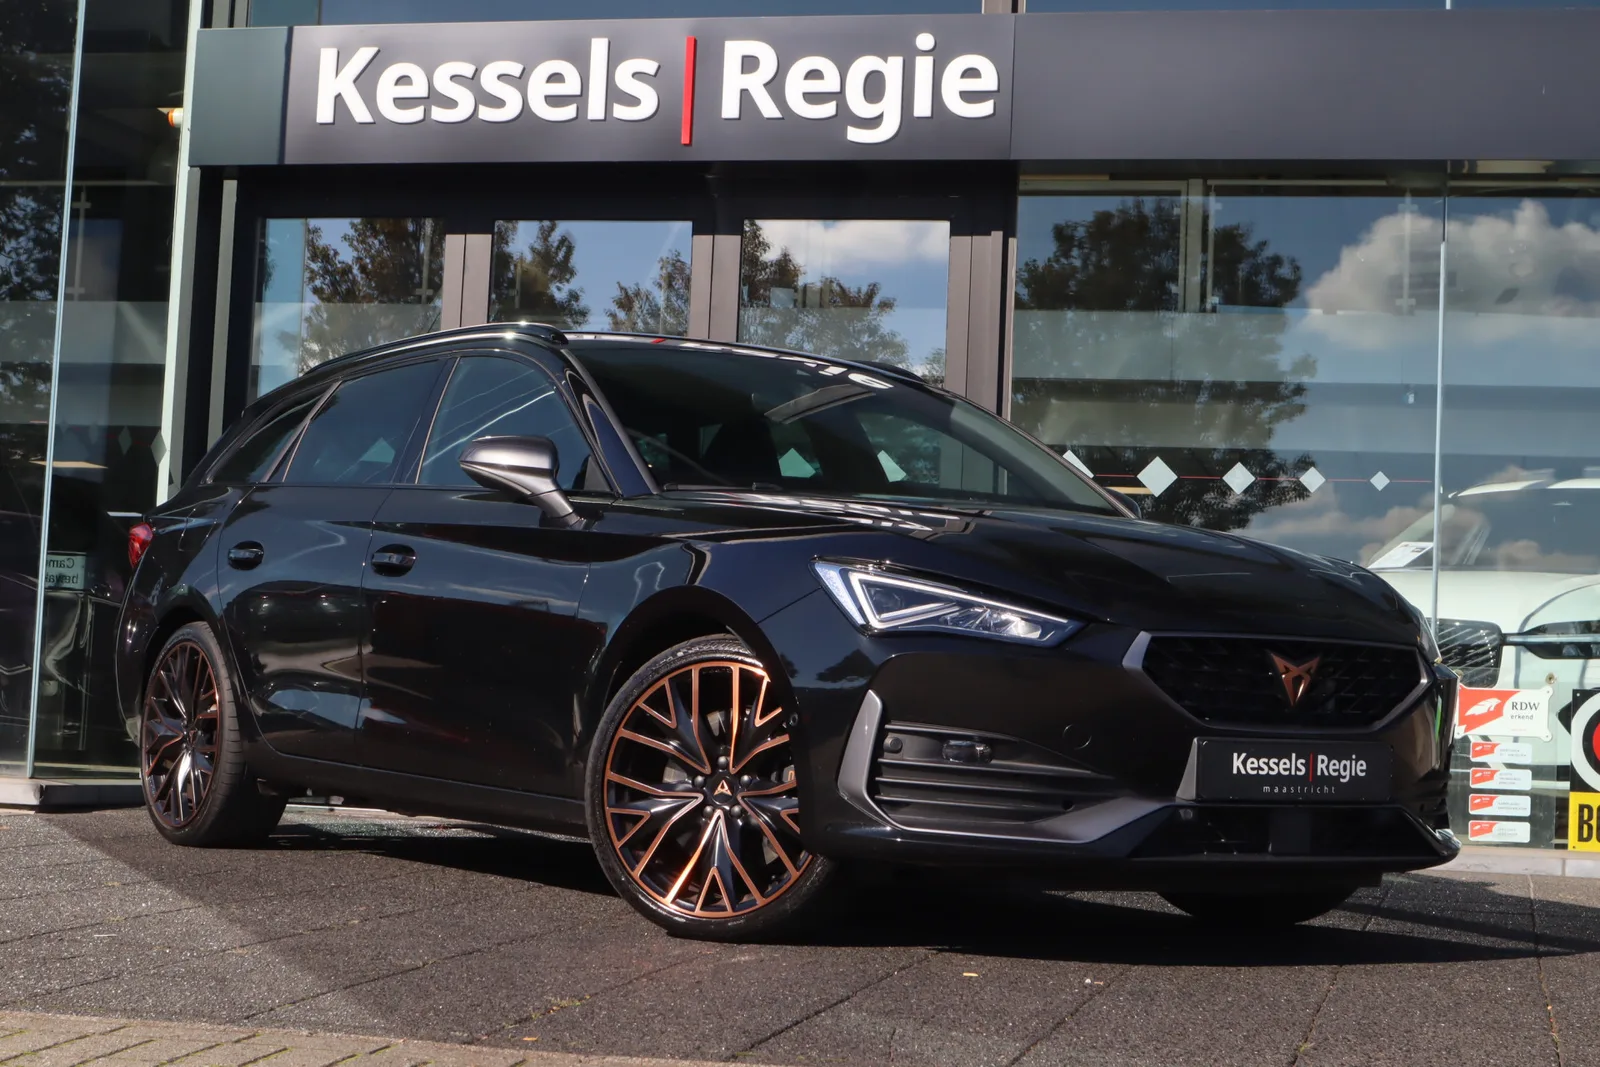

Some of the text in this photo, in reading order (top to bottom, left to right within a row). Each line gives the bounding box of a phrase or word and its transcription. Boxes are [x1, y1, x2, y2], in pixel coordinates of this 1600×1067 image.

[315, 32, 999, 144] Kessels Regie
[1511, 701, 1540, 711] RDW
[1232, 752, 1367, 783] Kessels Regie
[1262, 784, 1336, 794] maastricht
